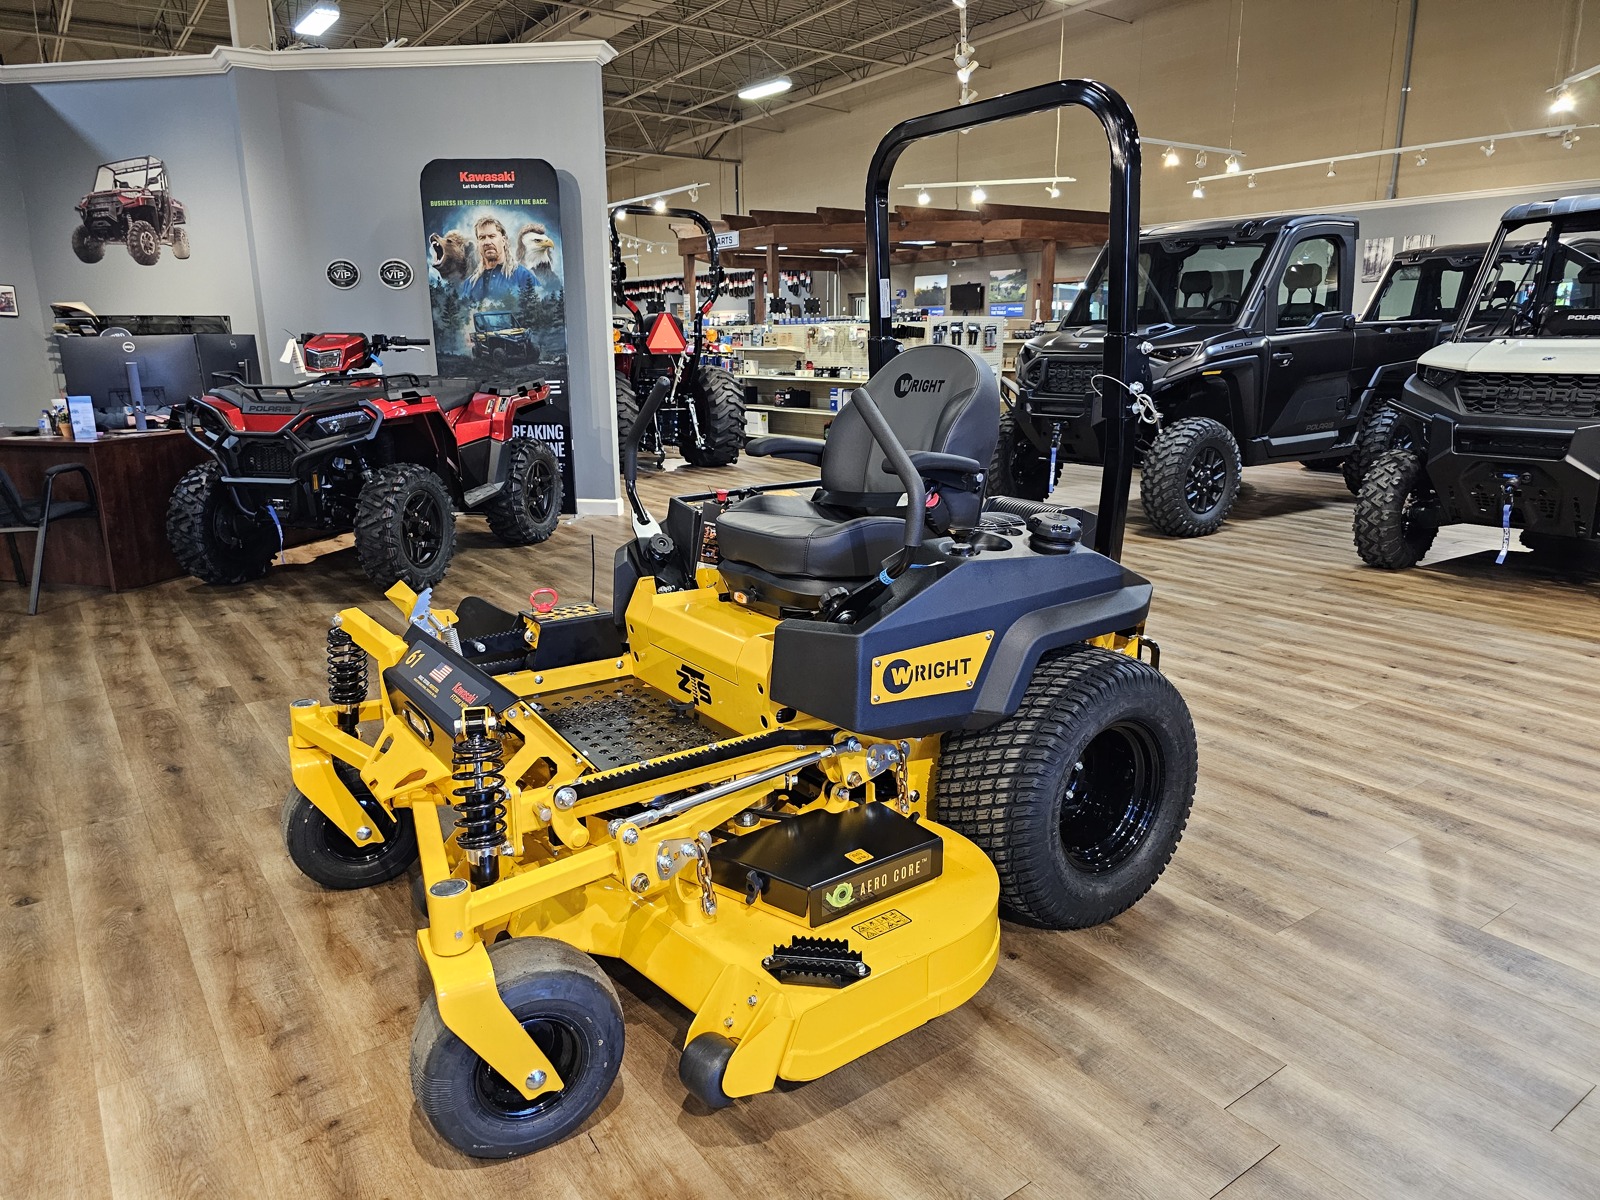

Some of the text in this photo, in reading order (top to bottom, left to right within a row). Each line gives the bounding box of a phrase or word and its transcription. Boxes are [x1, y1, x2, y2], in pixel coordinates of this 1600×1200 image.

[460, 171, 515, 182] Kawasaki
[717, 236, 733, 245] ARTS
[333, 271, 351, 279] VIP
[386, 271, 404, 279] VIP
[1221, 341, 1253, 350] 1500
[897, 376, 945, 394] WRIGHT
[1479, 386, 1597, 402] POLARIS
[512, 424, 564, 440] REAKING
[1305, 421, 1335, 431] POLARIS
[405, 649, 426, 668] 61
[889, 658, 972, 687] WRIGHT
[451, 681, 479, 704] Kawasaki
[860, 873, 888, 896] AERO
